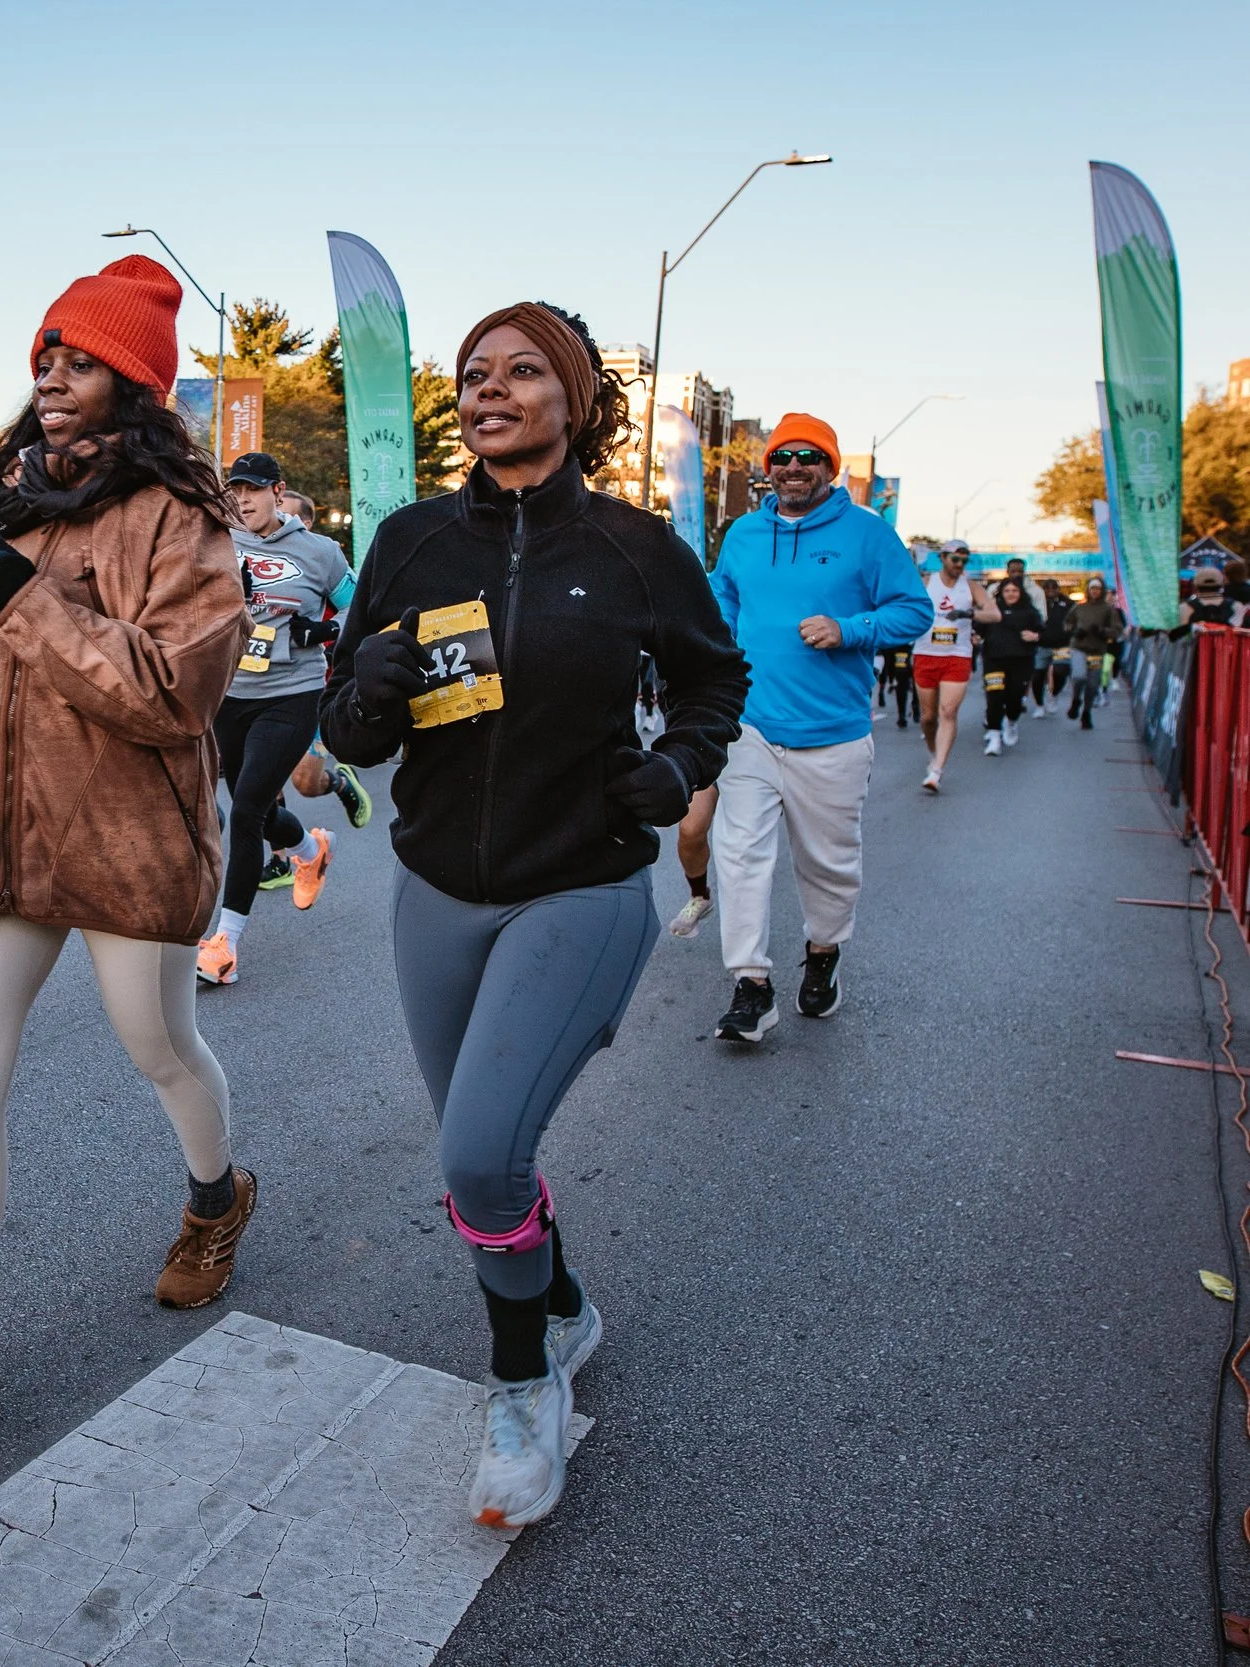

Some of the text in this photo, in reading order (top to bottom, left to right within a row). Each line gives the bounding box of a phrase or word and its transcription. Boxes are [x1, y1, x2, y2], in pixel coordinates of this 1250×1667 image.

[231, 410, 241, 450] Nelson
[241, 394, 250, 433] Atkins
[251, 604, 270, 614] CITY
